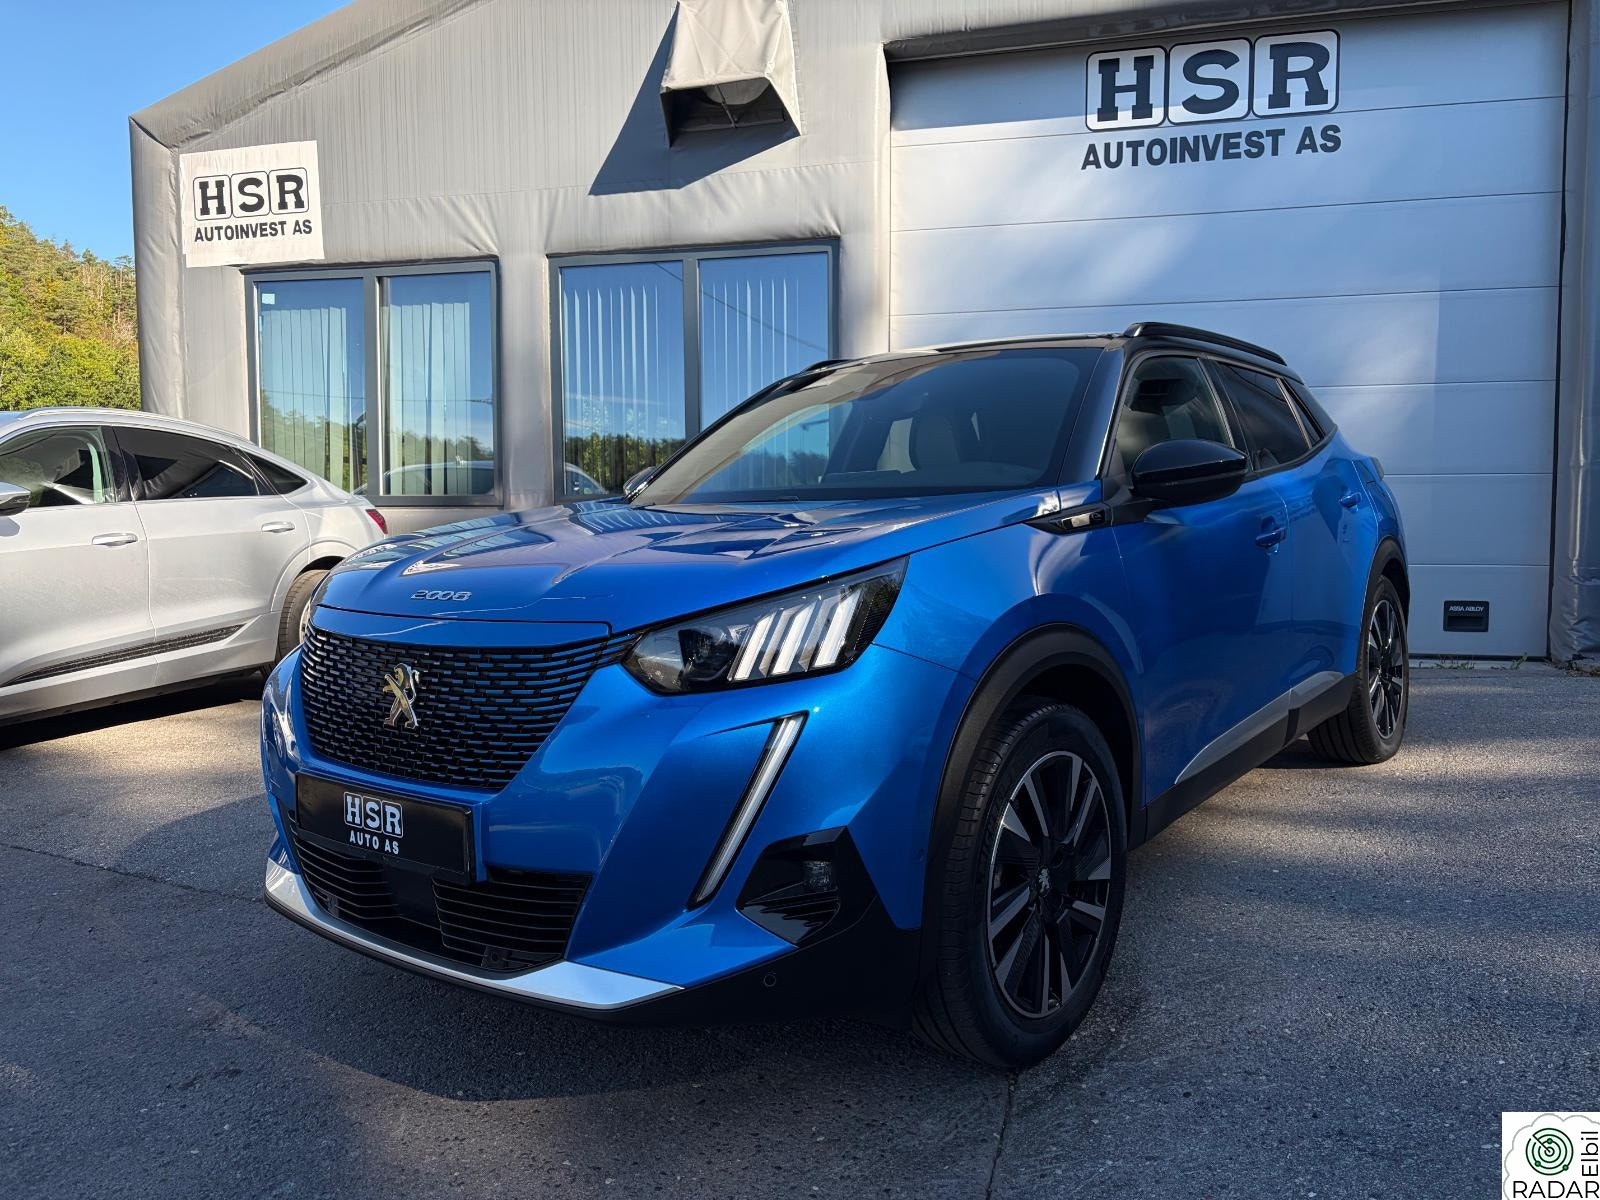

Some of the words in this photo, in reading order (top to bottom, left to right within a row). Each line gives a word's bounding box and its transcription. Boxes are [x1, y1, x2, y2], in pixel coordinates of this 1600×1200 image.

[1097, 41, 1330, 123] HSR
[1081, 128, 1286, 170] AUTOINVEST
[1296, 124, 1342, 155] AS
[198, 174, 305, 216] HSR
[194, 220, 287, 242] AUTOINVEST
[292, 219, 313, 236] AS
[410, 589, 473, 601] 2008
[346, 795, 401, 835] HSR
[350, 829, 380, 850] AUTO
[384, 839, 399, 855] AS
